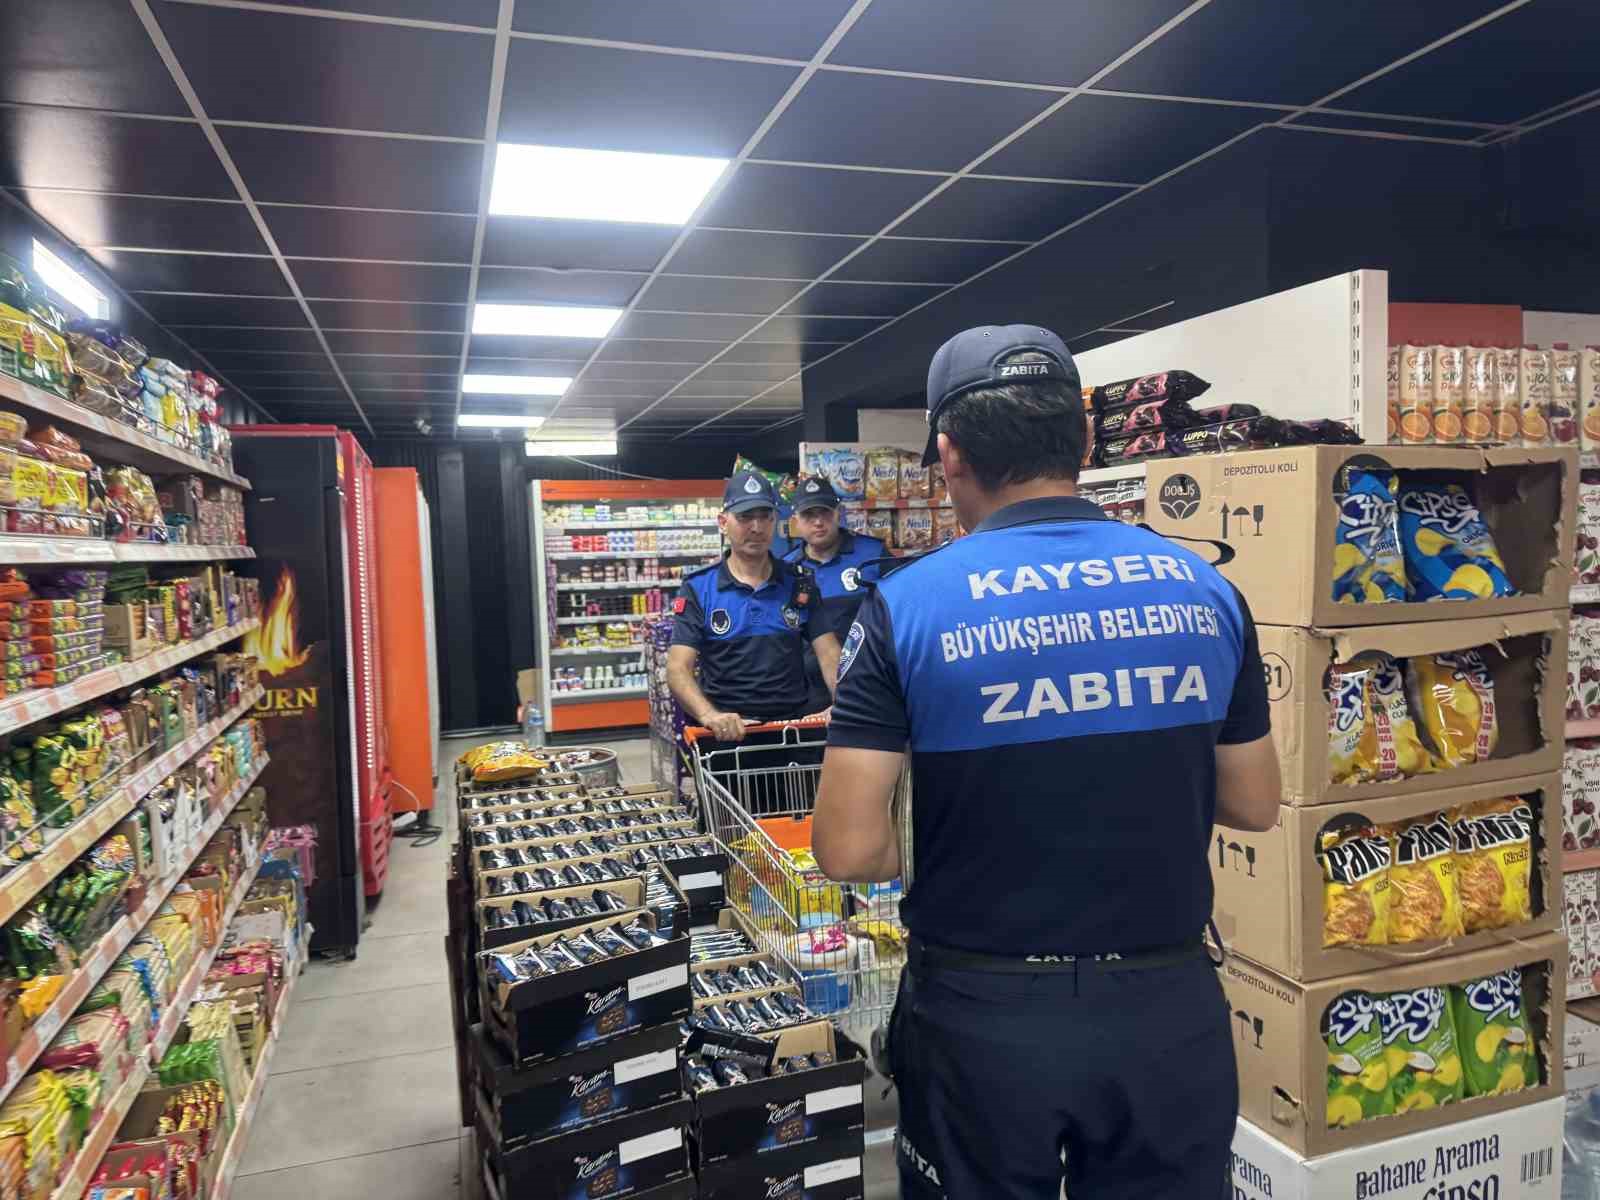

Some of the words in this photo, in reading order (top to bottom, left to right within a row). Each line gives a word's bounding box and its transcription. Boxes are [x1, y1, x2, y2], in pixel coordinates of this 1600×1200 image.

[1001, 365, 1049, 376] ZABITA
[1183, 431, 1208, 442] LUPPO
[1224, 463, 1275, 477] DEPOZİTOLU
[980, 665, 1209, 724] ZABITA
[1356, 1157, 1427, 1200] Bahane
[1433, 1133, 1500, 1178] Arama
